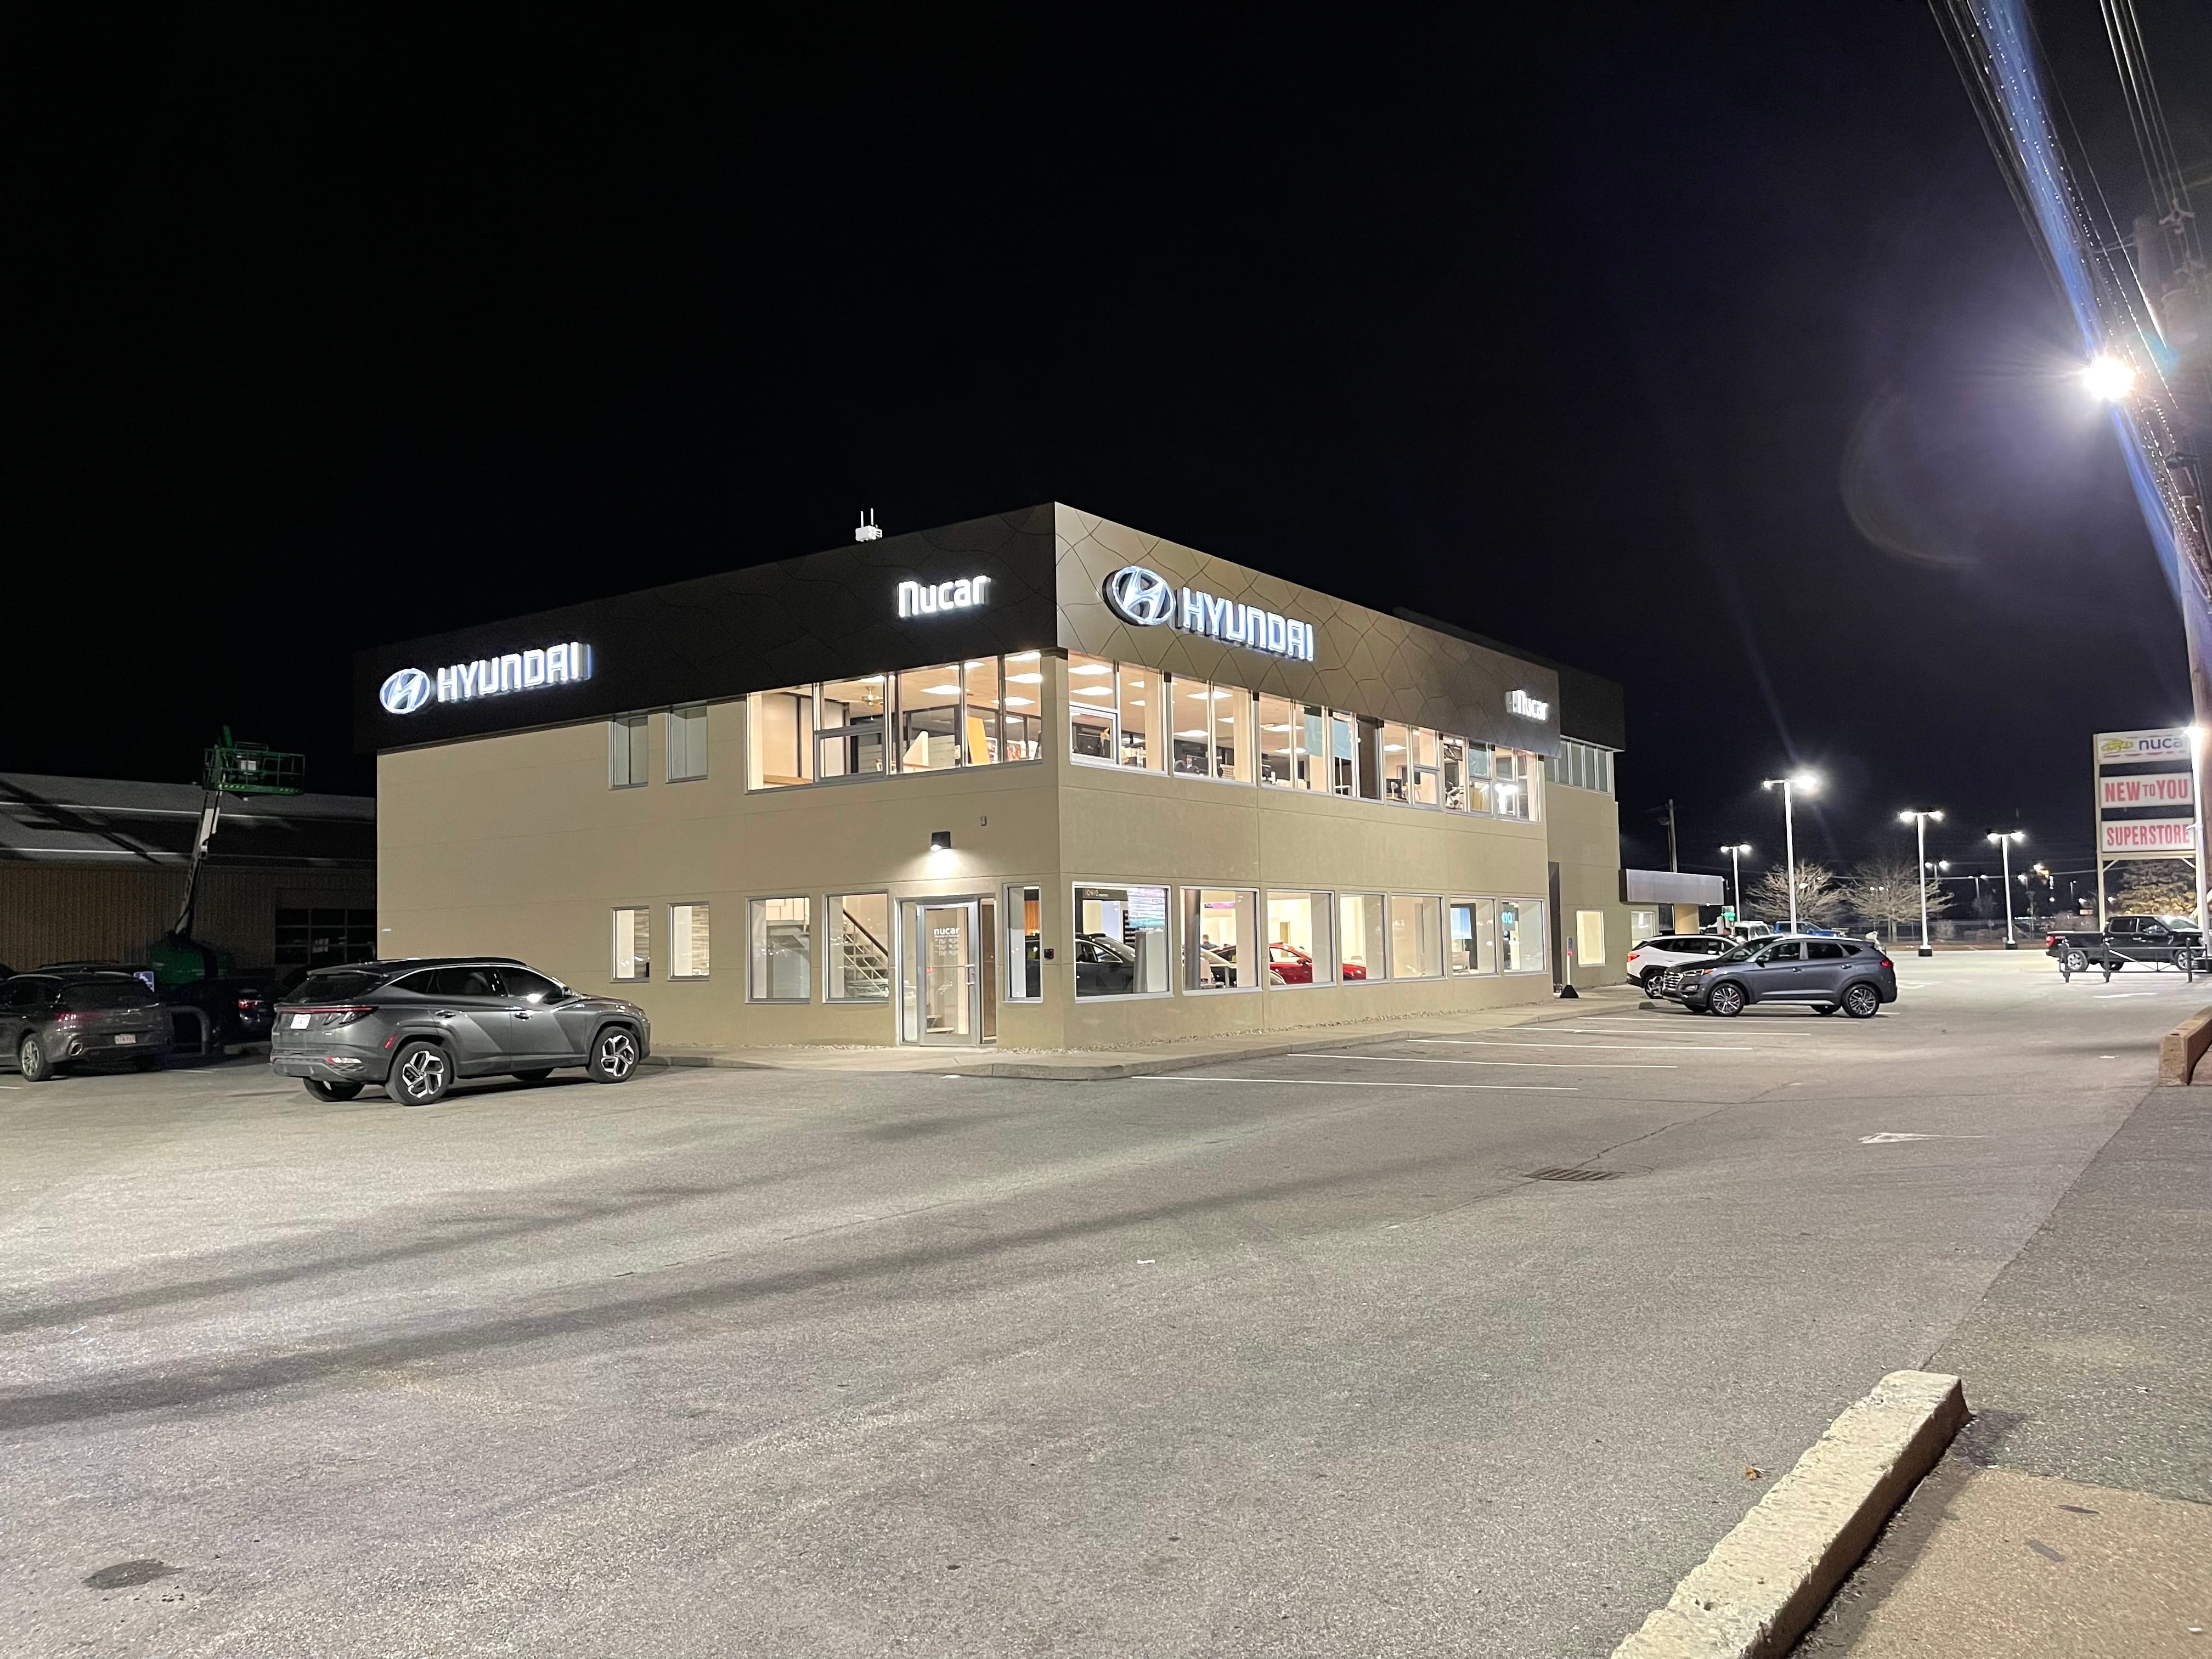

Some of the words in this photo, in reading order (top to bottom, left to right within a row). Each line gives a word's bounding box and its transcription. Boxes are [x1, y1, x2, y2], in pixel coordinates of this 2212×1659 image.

[1183, 586, 1313, 662] HYUNDAI
[437, 641, 582, 703] HYUNDAI
[2139, 738, 2187, 750] nuca
[2105, 782, 2141, 802] NEW
[2142, 784, 2155, 797] TO
[2156, 778, 2188, 799] YOU
[2107, 824, 2190, 847] SUPERSTORE
[934, 927, 960, 935] nucar
